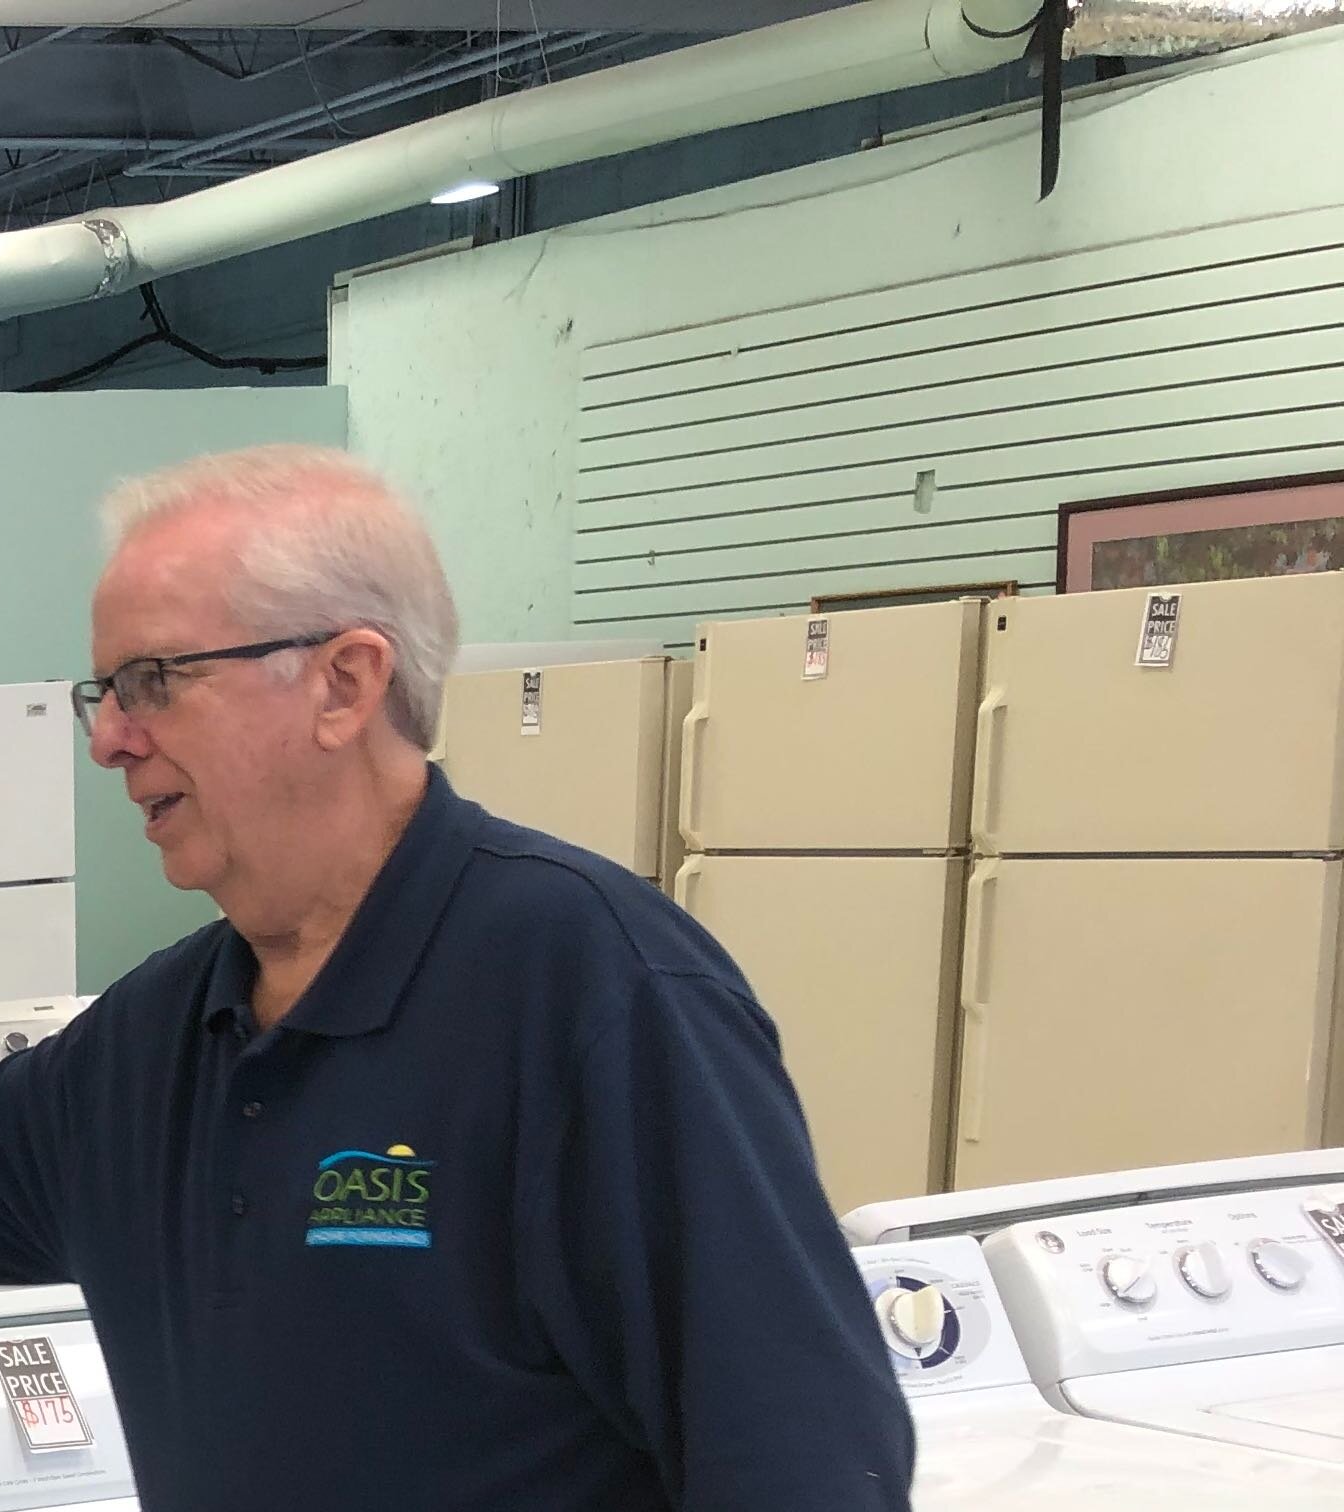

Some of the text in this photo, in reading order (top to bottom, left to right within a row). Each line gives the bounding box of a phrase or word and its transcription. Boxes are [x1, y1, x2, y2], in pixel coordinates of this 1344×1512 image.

[1152, 602, 1176, 616] SALE
[1147, 620, 1175, 634] PRICE
[313, 1167, 431, 1204] OASIS
[308, 1207, 426, 1226] APPLIANCE
[5, 1372, 67, 1397] PRICE
[20, 1396, 74, 1428] $175
